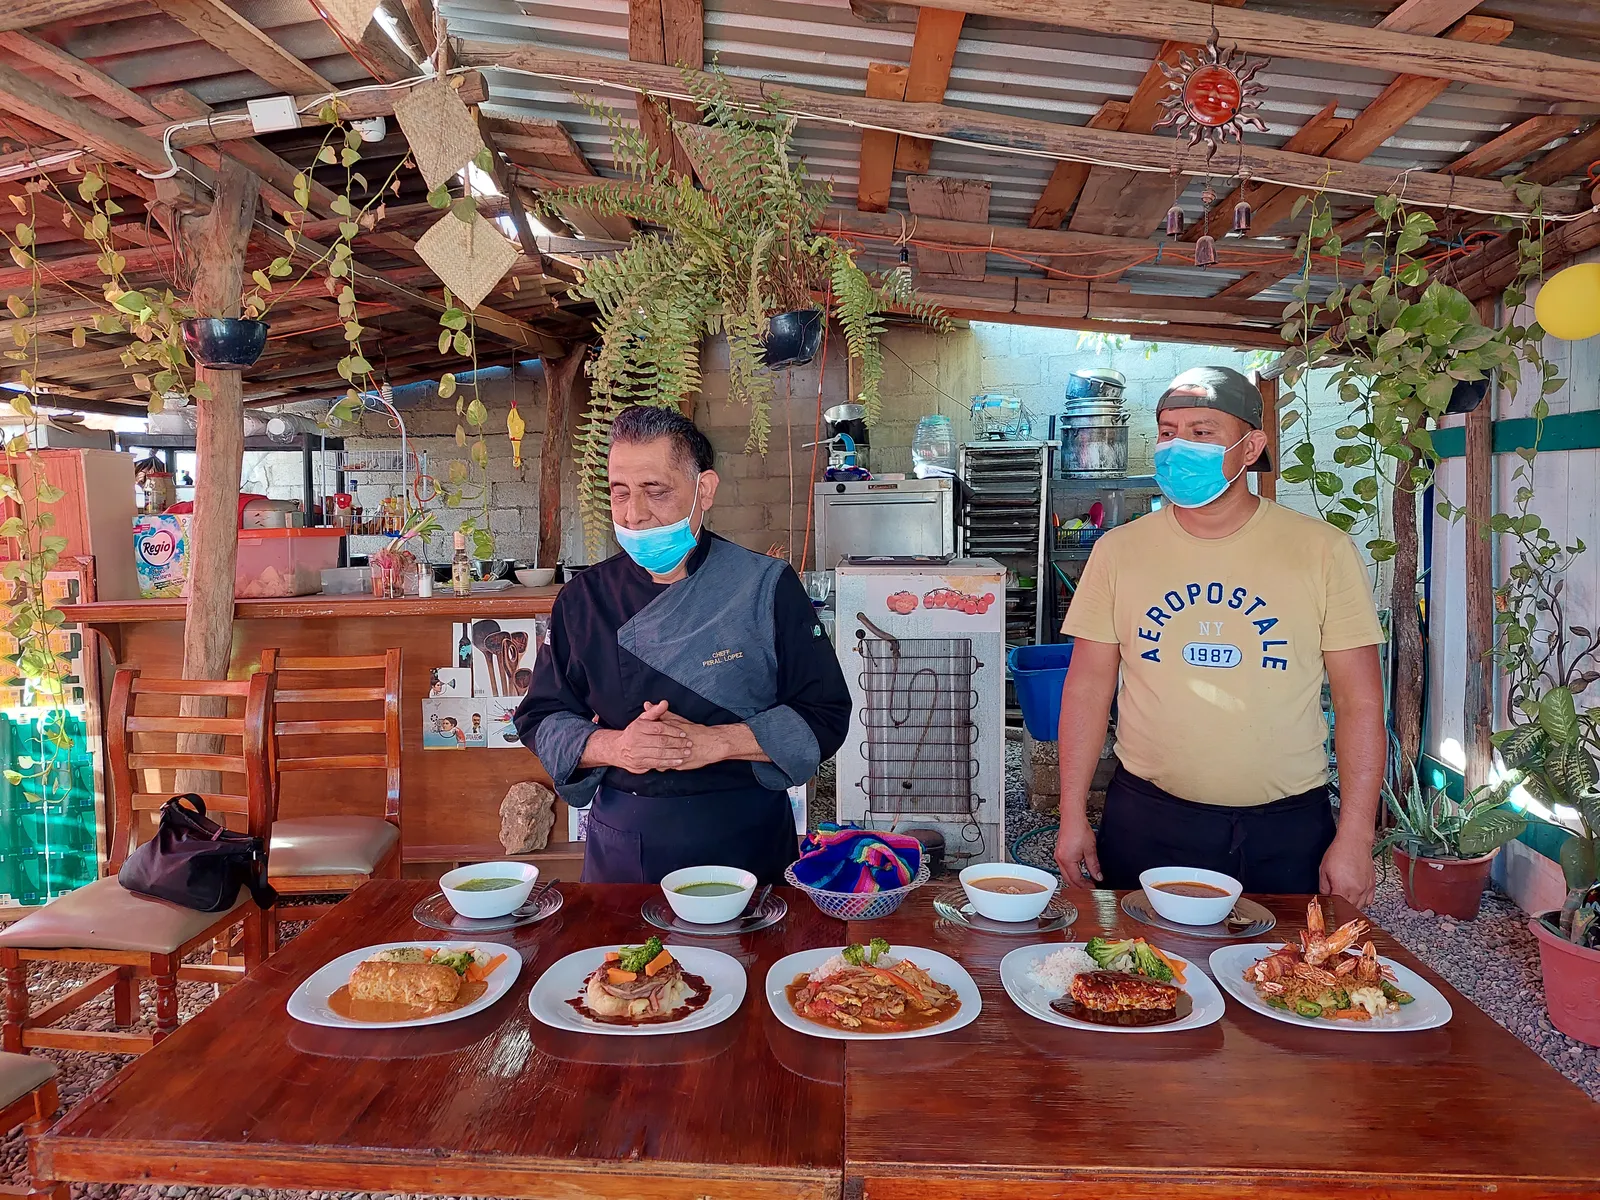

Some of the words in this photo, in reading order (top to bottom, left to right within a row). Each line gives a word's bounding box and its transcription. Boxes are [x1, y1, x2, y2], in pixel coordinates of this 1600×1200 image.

[143, 541, 170, 556] Regio
[1138, 582, 1288, 671] AEROPOSTALE
[1198, 621, 1224, 636] NY
[724, 652, 743, 661] LOPEZ
[1189, 647, 1234, 664] 1987
